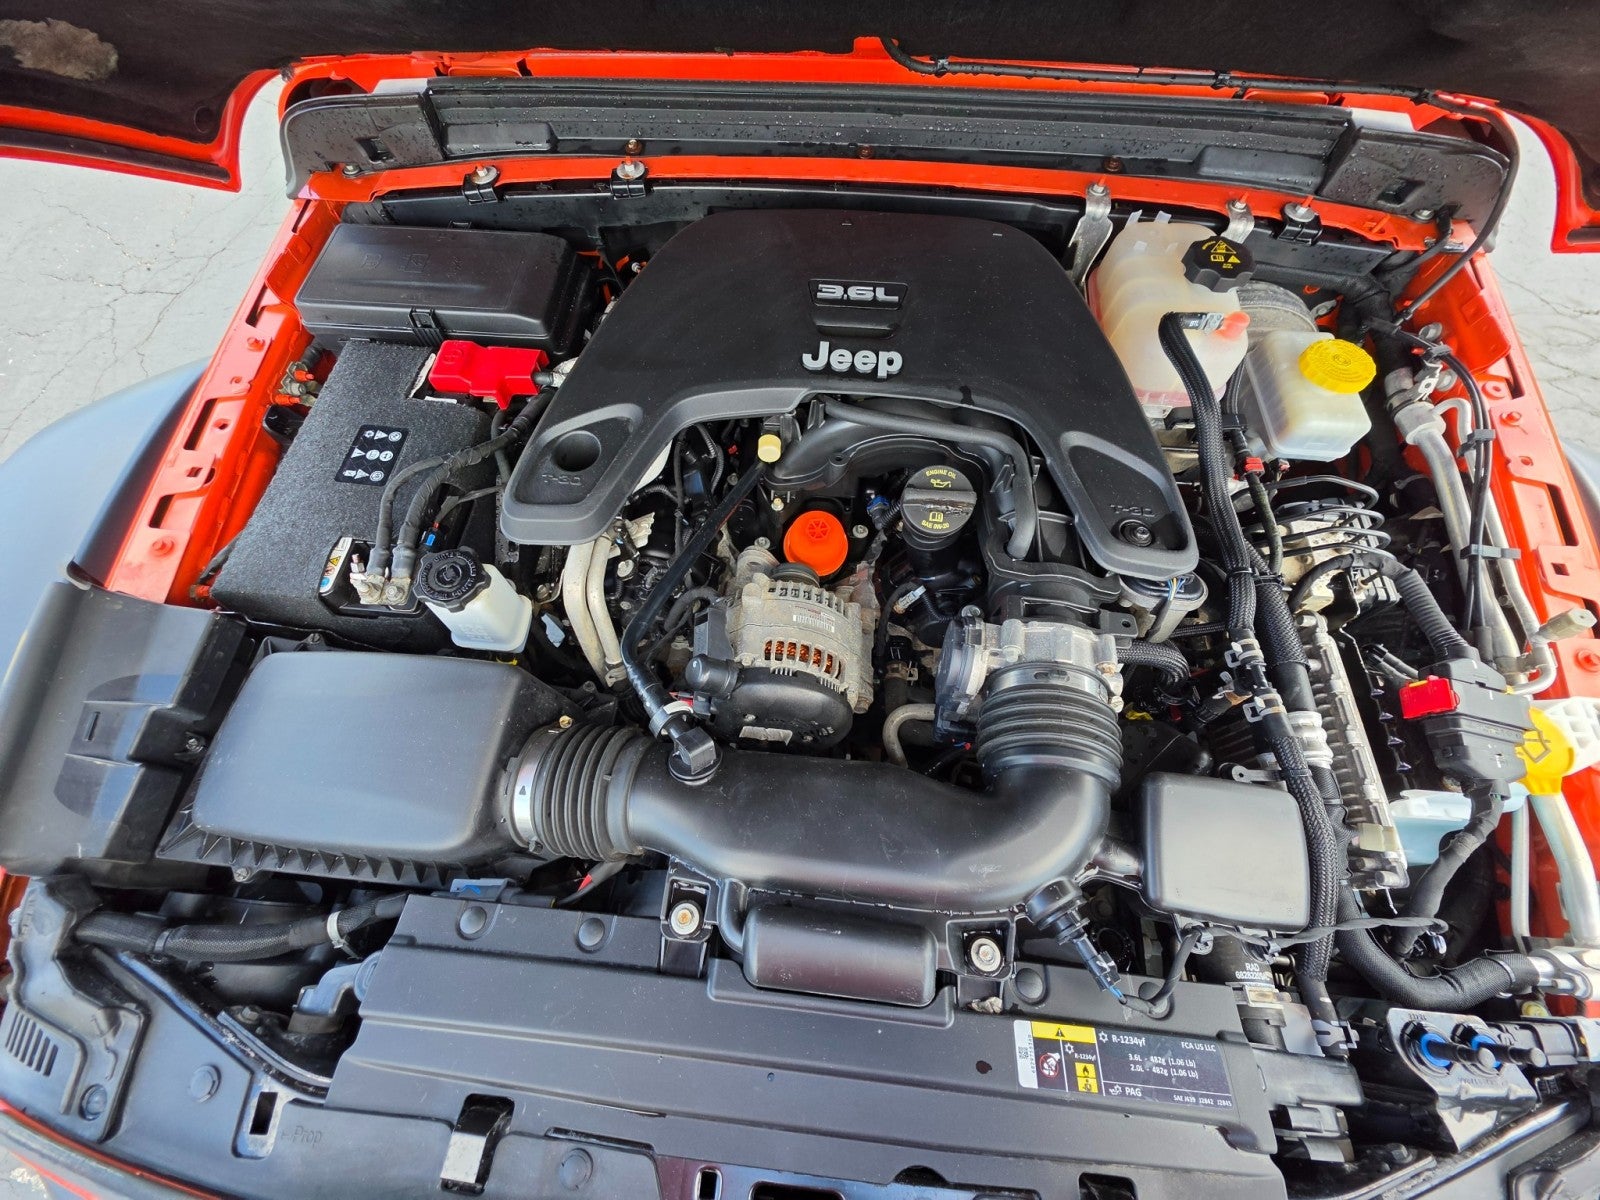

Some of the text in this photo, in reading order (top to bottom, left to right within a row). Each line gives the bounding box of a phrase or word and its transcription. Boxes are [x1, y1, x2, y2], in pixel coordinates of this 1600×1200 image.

[816, 283, 899, 303] 3.6L
[802, 341, 903, 379] Jeep
[925, 468, 957, 480] ENGINE OIL
[921, 519, 932, 529] SAE
[1245, 962, 1260, 971] RAD
[1111, 1033, 1146, 1048] R-1234yf
[1181, 1041, 1216, 1053] FCA US LLC
[1128, 1053, 1143, 1062] 3.6L
[1150, 1055, 1166, 1066] 482g
[1168, 1056, 1185, 1067] (1.06
[1186, 1058, 1197, 1069] Lb)
[1129, 1063, 1144, 1072] 2.0L
[1152, 1066, 1169, 1077] 482g
[1170, 1067, 1187, 1078] (1.06
[1188, 1069, 1199, 1080] Lb)
[1125, 1086, 1143, 1097] PAG
[1173, 1094, 1183, 1102] SAE
[292, 1125, 323, 1149] Prop
